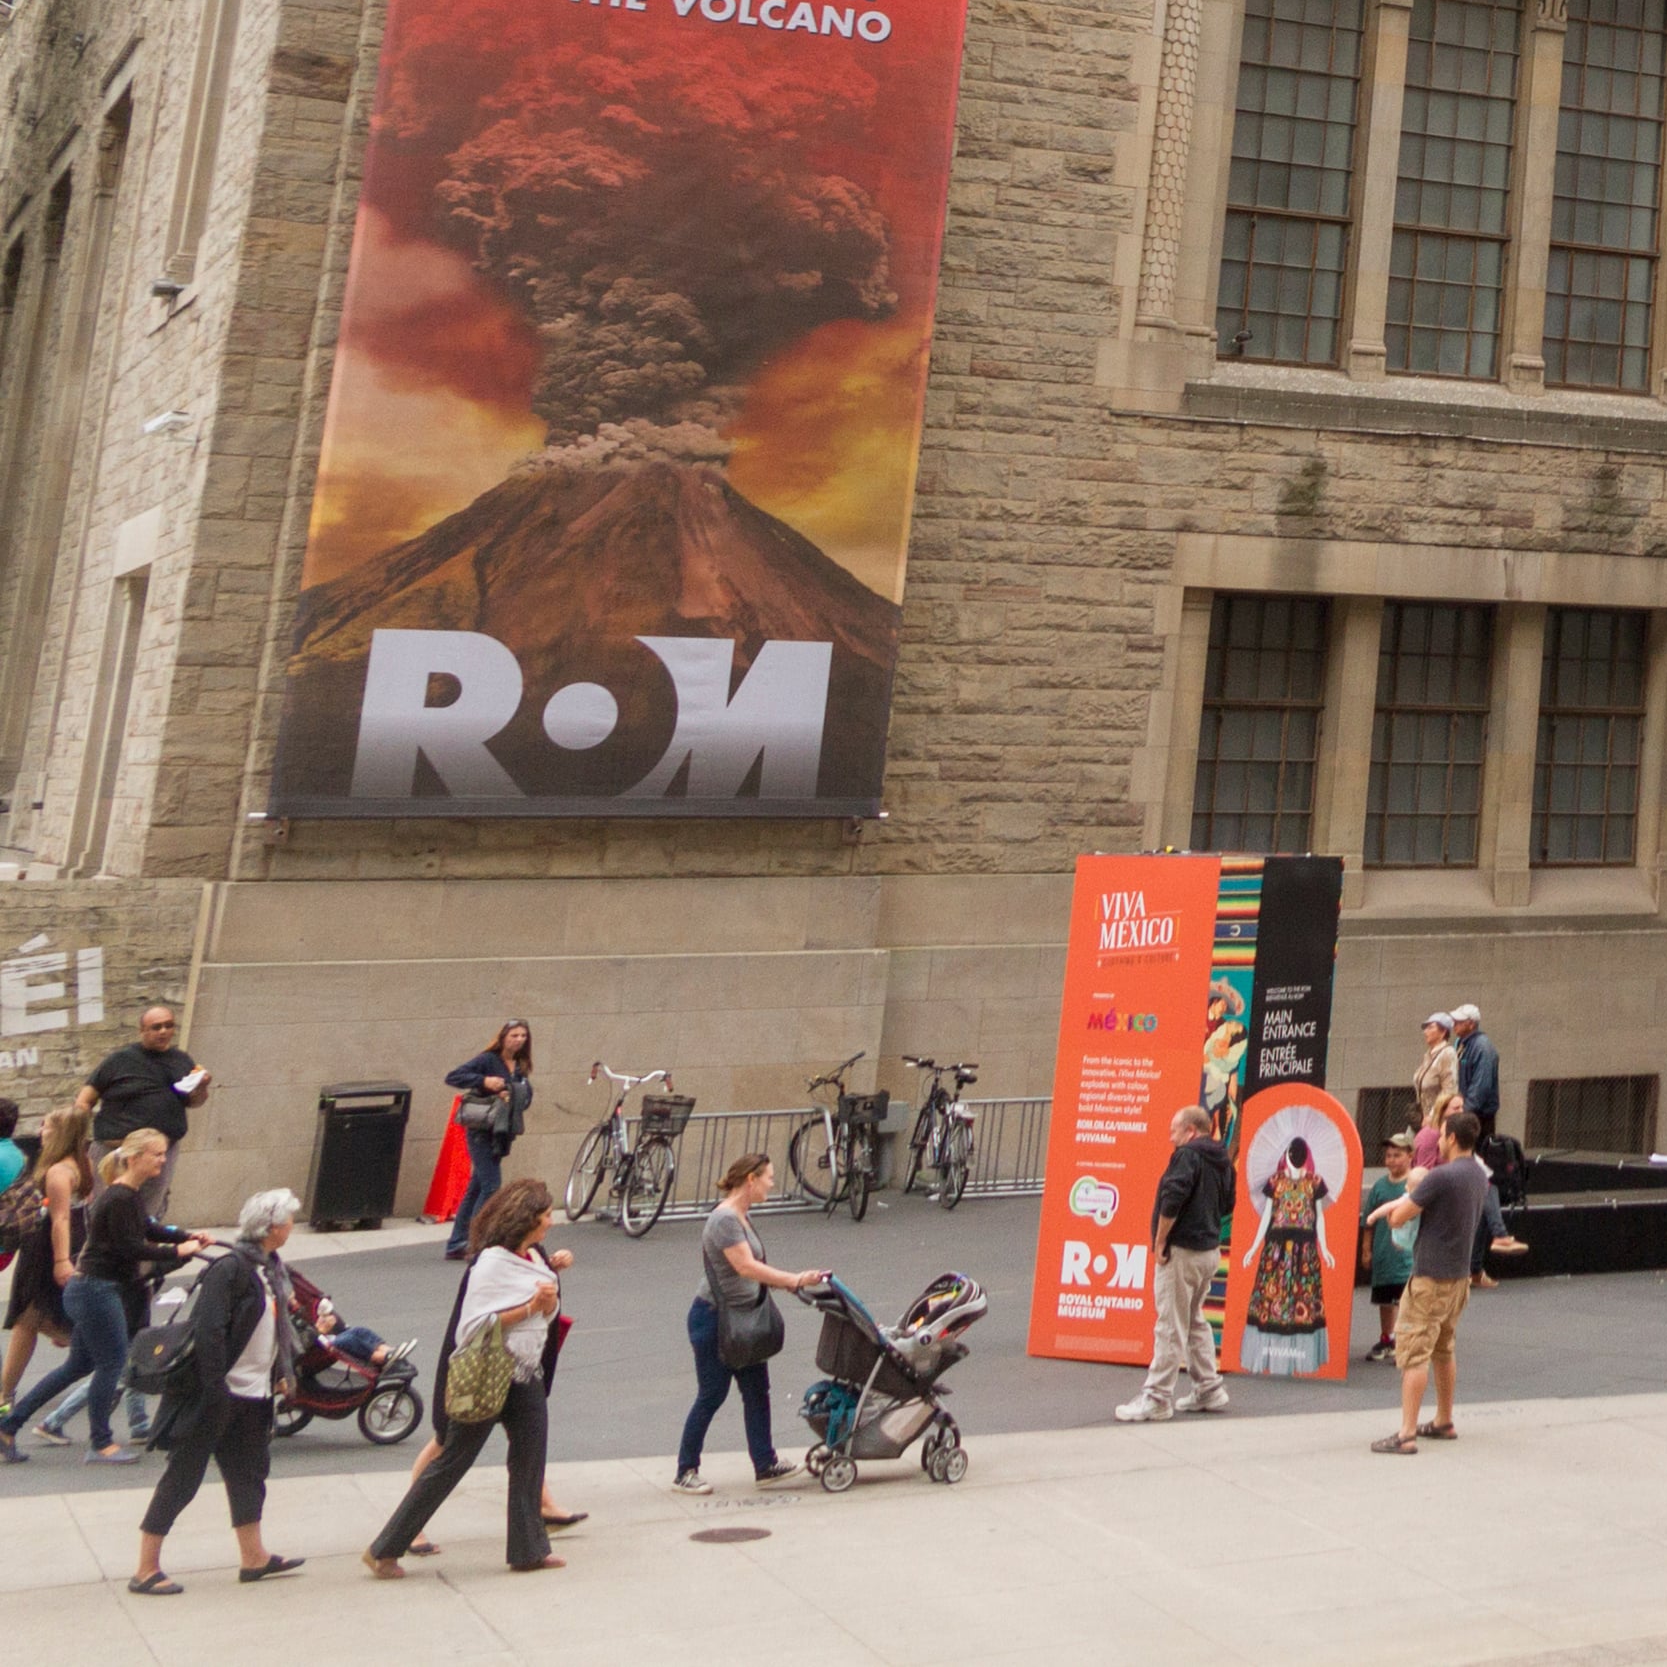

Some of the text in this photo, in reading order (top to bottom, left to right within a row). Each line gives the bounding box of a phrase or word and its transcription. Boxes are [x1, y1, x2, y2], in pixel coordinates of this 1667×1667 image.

[1101, 891, 1146, 921] VIVA
[1099, 916, 1174, 950] MÉXICO
[0, 933, 104, 1036] ÉI
[1264, 1008, 1293, 1025] MAIN
[1262, 1021, 1317, 1041] ENTRANCE
[0, 1046, 38, 1068] AN
[1260, 1042, 1297, 1062] ENTRÉE
[1259, 1057, 1313, 1078] PRINCIPALE
[1059, 1292, 1144, 1311] ROYAL ONTARIO
[1057, 1305, 1106, 1320] MUSEUM
